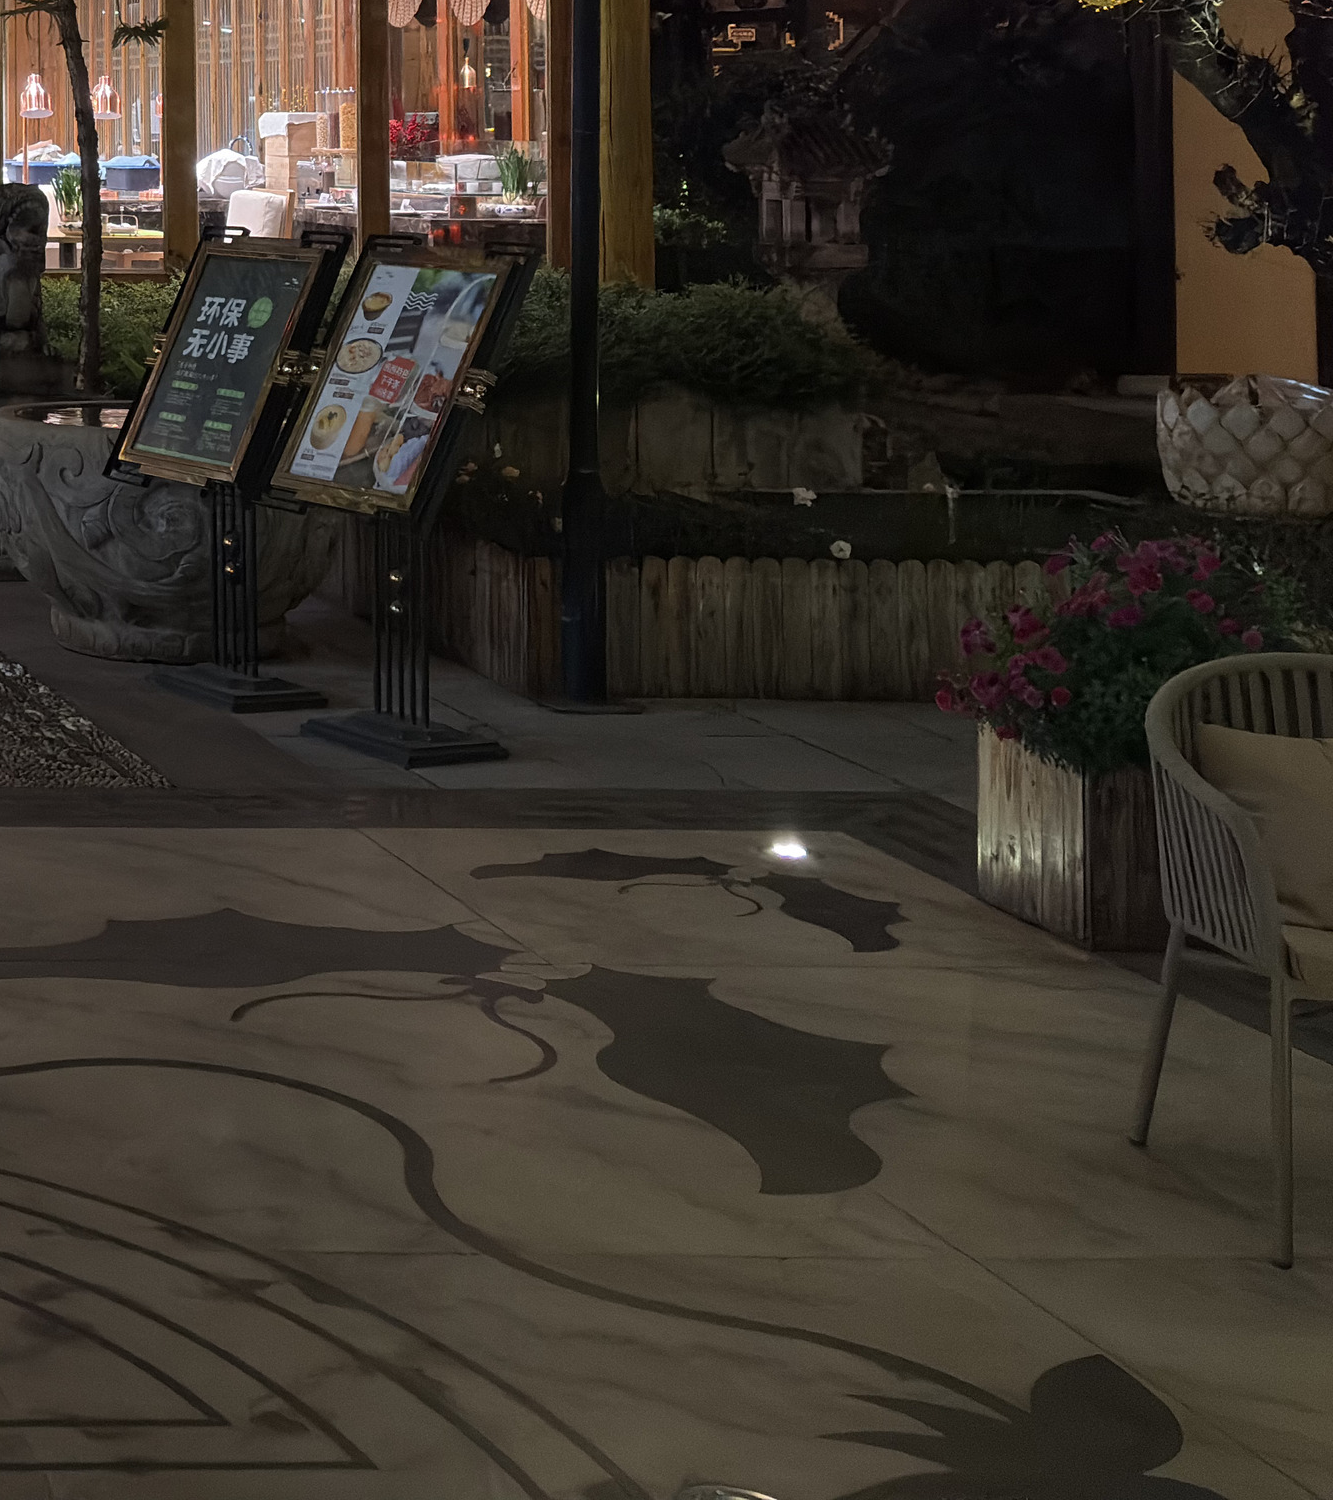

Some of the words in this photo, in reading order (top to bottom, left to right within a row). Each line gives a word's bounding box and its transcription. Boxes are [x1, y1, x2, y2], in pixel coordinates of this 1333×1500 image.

[195, 295, 248, 329] 环保
[181, 327, 255, 365] 无小事
